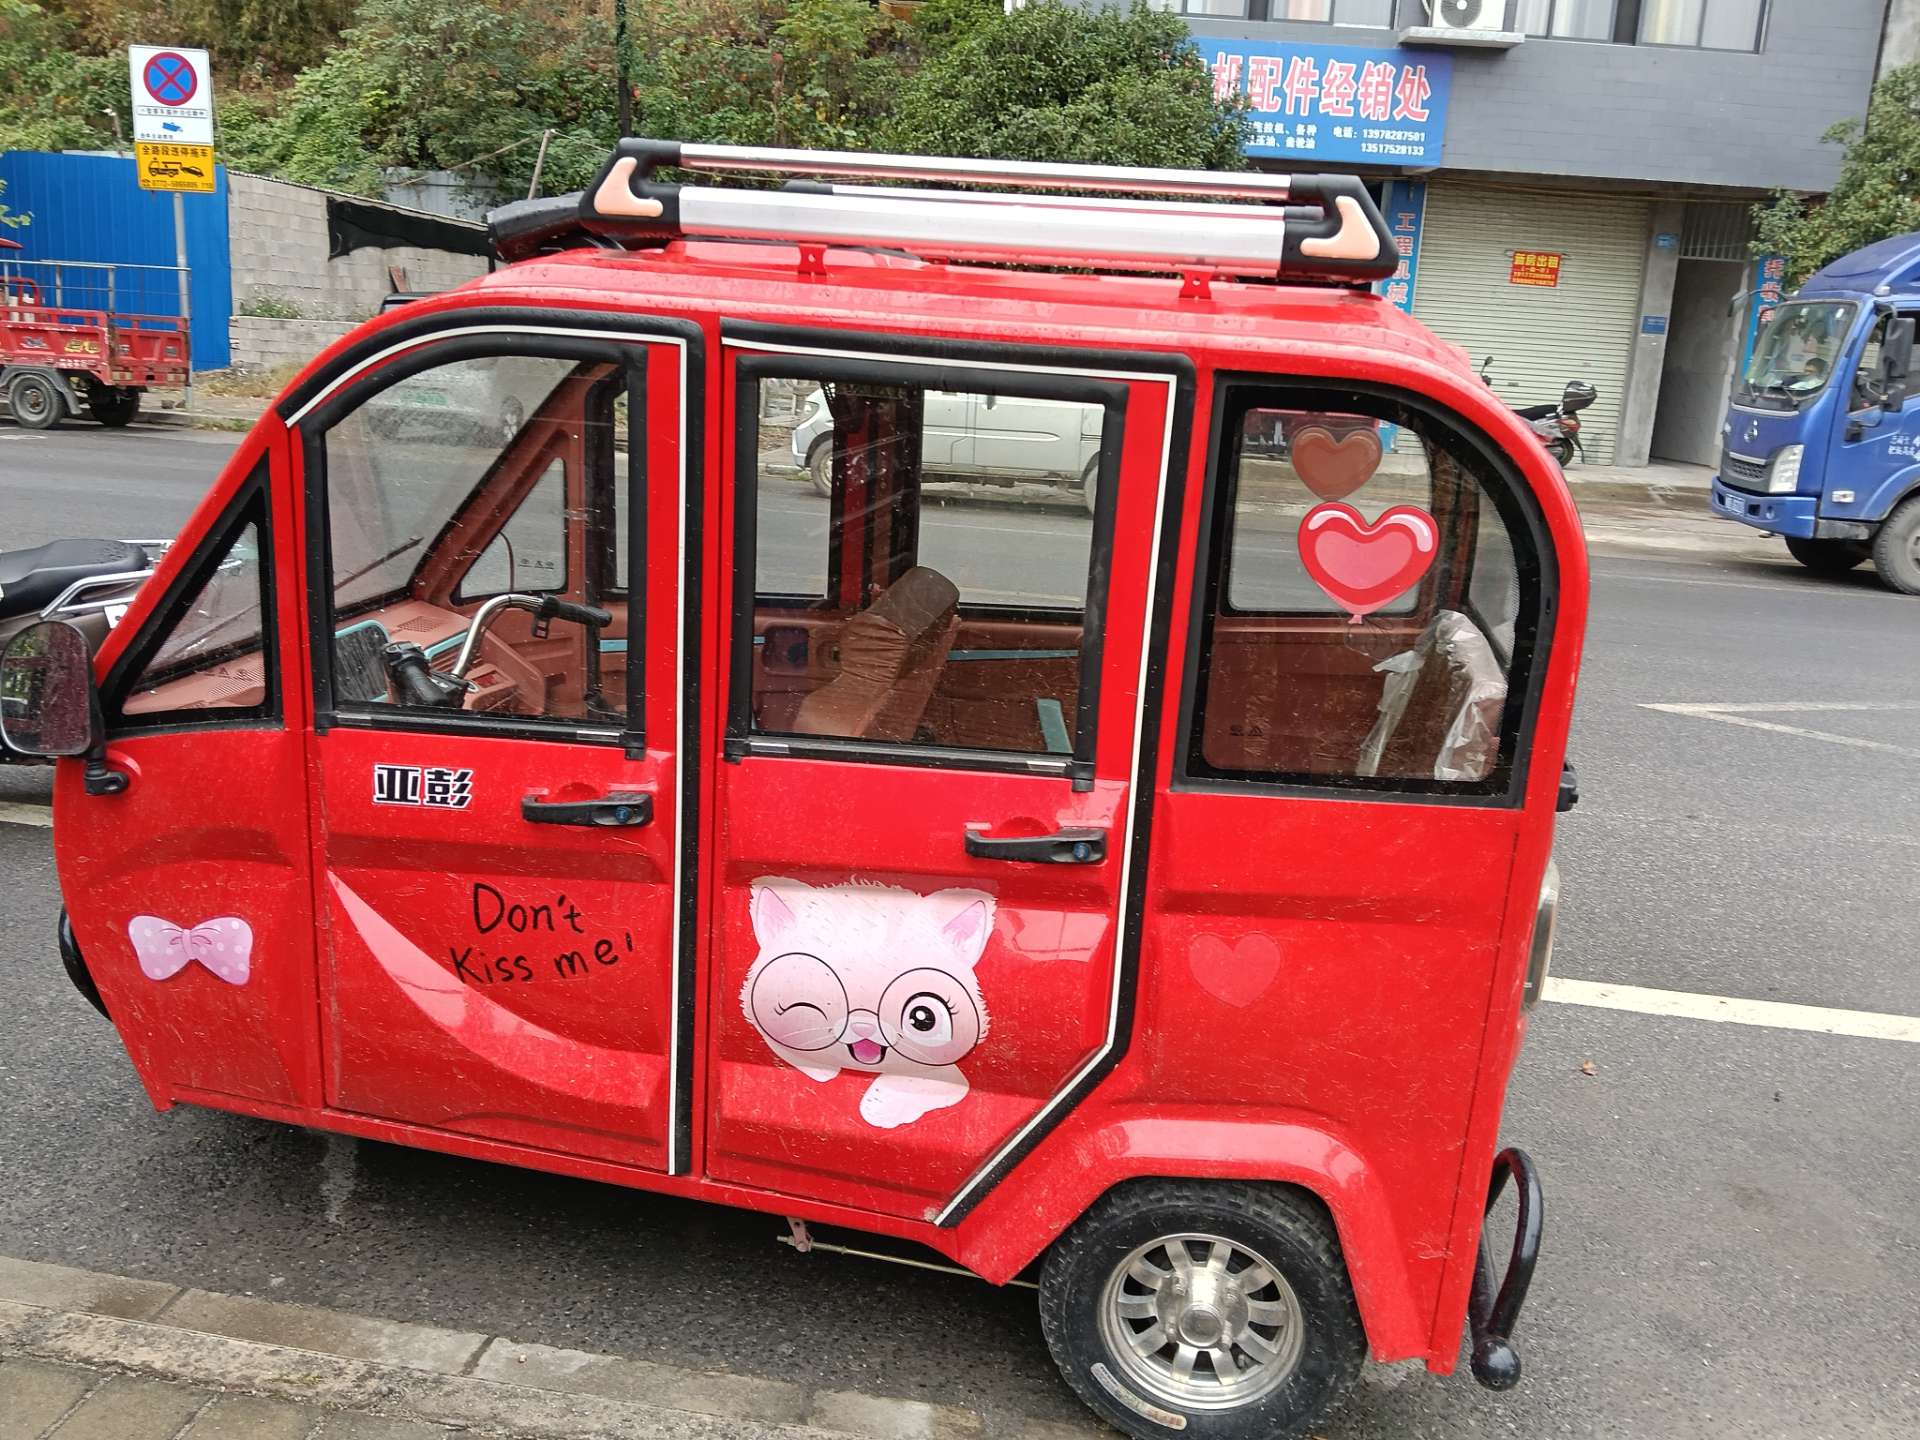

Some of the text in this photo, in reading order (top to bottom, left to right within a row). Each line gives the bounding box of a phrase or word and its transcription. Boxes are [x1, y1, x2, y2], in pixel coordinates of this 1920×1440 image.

[1199, 51, 1432, 122] 机配件经销处
[1387, 212, 1416, 312] 工程机械
[373, 765, 473, 809] 亚彭
[473, 883, 584, 934] Don't
[450, 947, 534, 984] Kiss
